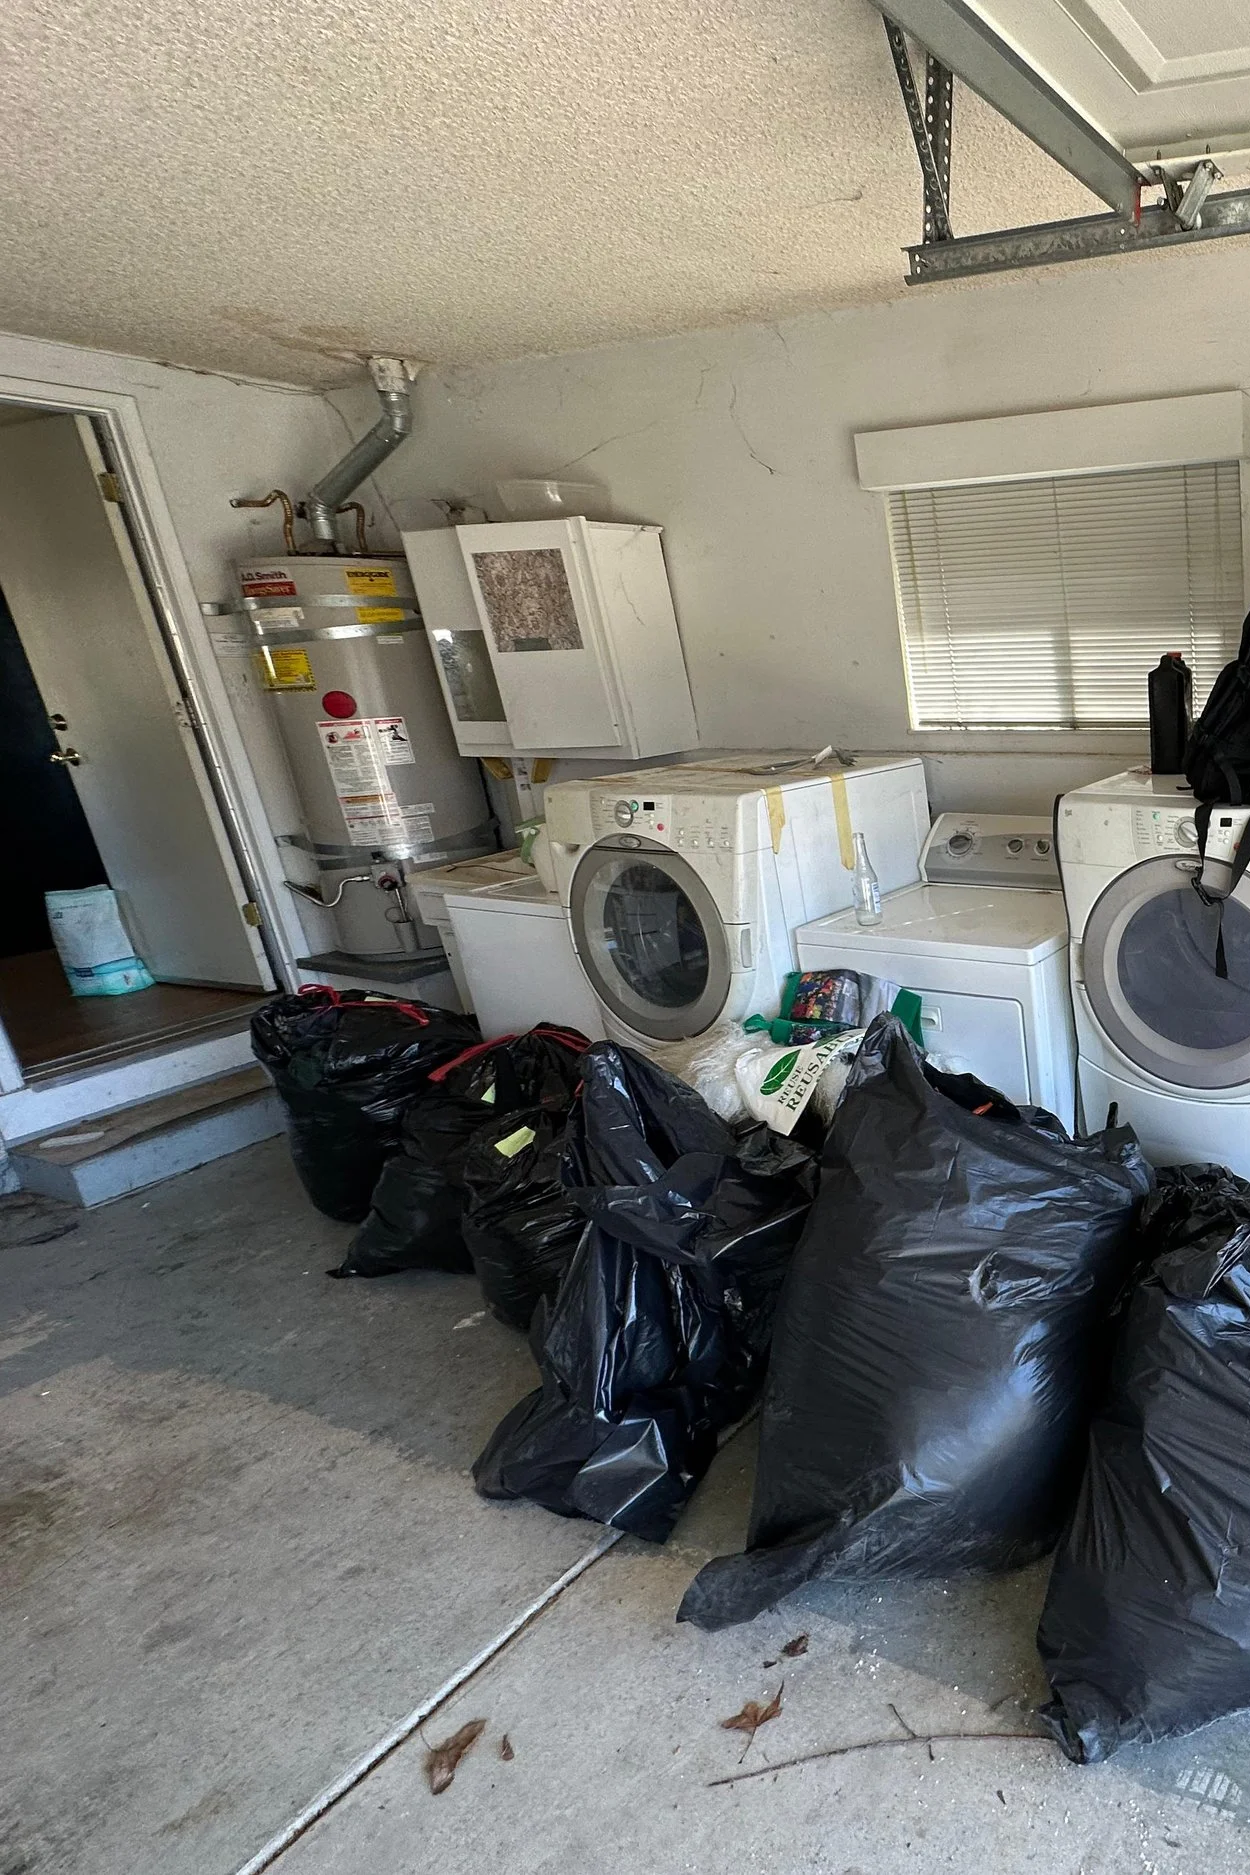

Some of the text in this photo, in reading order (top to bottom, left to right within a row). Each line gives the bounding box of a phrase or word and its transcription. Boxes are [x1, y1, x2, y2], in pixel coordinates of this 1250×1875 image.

[255, 571, 288, 580] Smith
[777, 1065, 804, 1104] REUSE
[785, 1034, 855, 1112] REUSABL
